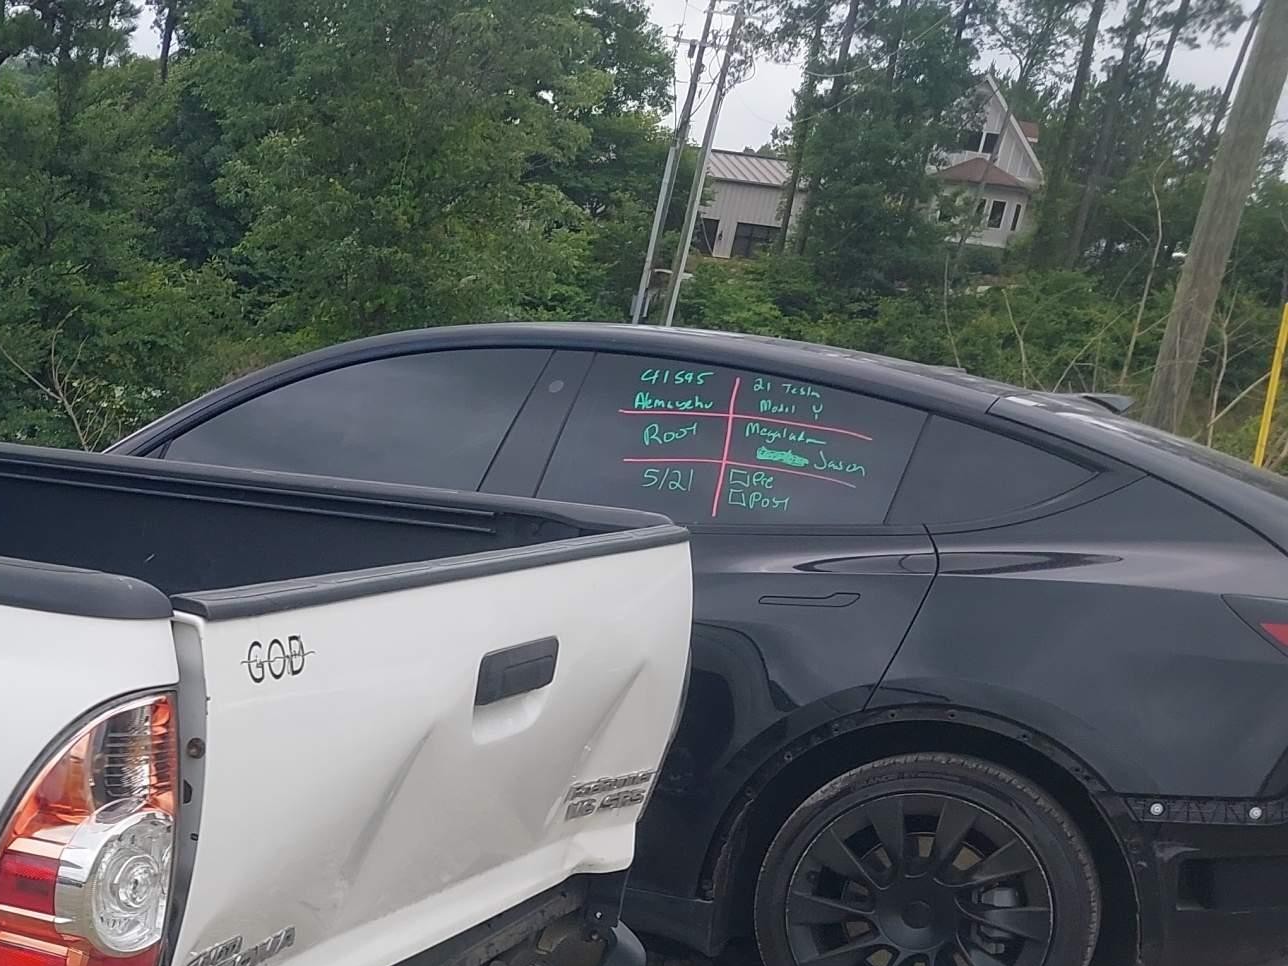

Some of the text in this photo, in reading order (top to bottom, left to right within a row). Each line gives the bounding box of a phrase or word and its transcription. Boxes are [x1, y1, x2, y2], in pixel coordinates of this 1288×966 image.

[753, 378, 771, 392] 21
[812, 403, 824, 421] Y
[643, 422, 699, 446] Root
[813, 450, 865, 477] Jason
[640, 468, 694, 492] 5/21
[752, 470, 774, 489] Pre
[749, 491, 790, 509] Post
[244, 634, 307, 684] GOD
